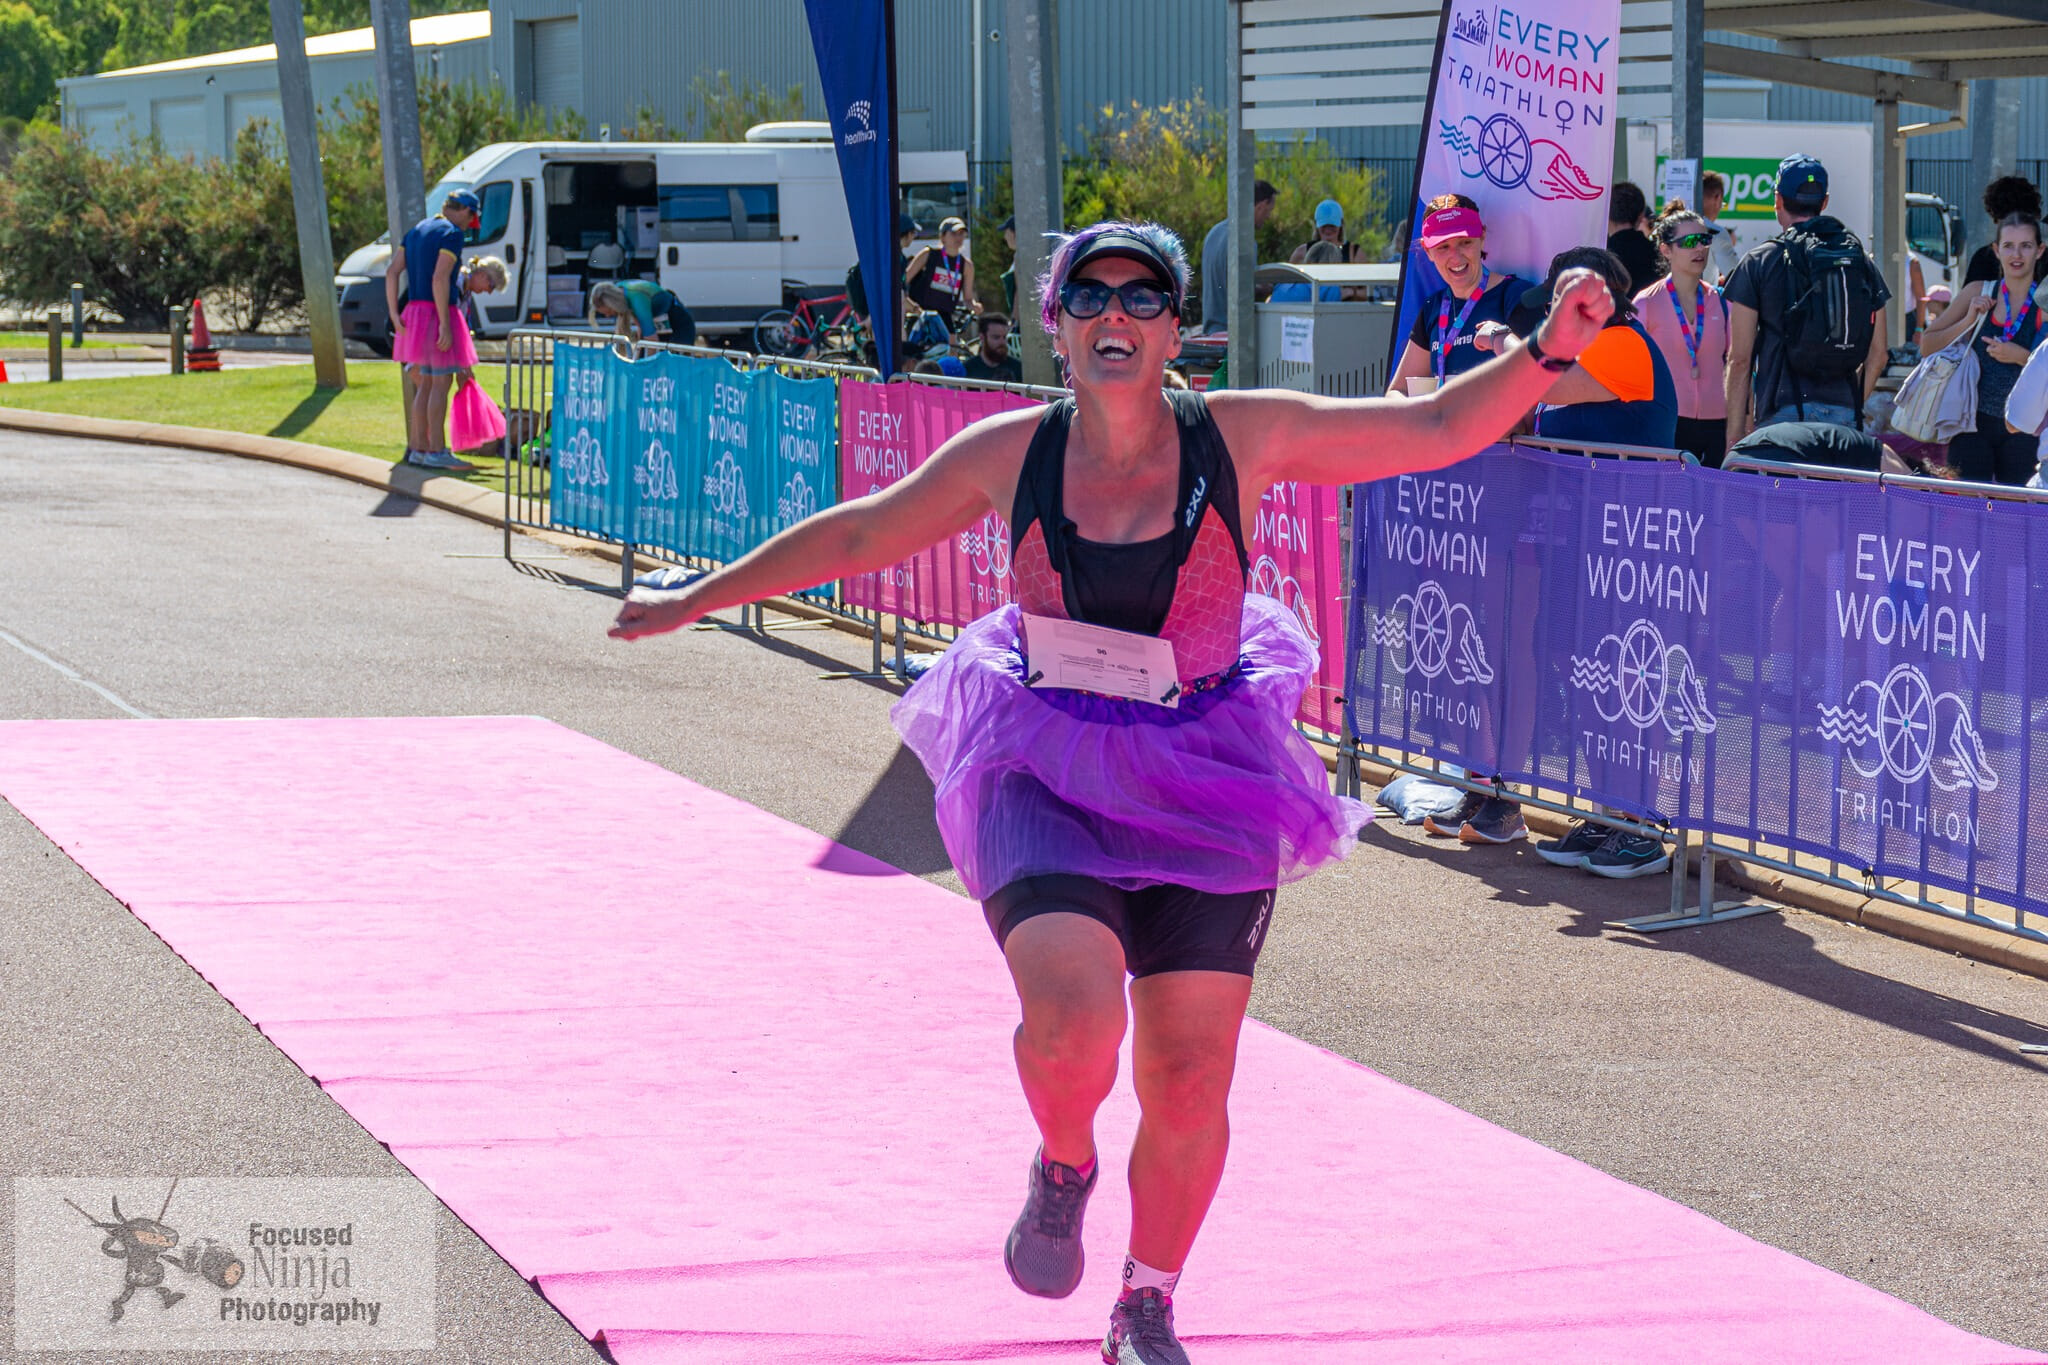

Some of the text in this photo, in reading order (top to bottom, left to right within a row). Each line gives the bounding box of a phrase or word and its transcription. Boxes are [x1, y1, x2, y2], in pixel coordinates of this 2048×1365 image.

[1498, 9, 1609, 63] EVERY
[1495, 45, 1604, 95] WOMAN
[1449, 56, 1604, 135] TRIATHLON
[568, 367, 605, 394] EVERY
[642, 376, 676, 402] EVERY
[714, 383, 748, 415] EVERY
[564, 395, 607, 424] WOMAN
[638, 407, 677, 435] WOMAN
[709, 414, 748, 449] WOMAN
[782, 398, 817, 432] EVERY
[858, 409, 903, 442] EVERY
[779, 432, 819, 468] WOMAN
[853, 444, 908, 479] WOMAN
[1398, 474, 1484, 524] EVERY
[1385, 520, 1487, 577] WOMAN
[1602, 502, 1705, 556] EVERY
[1586, 552, 1708, 616] WOMAN
[1855, 533, 1981, 597] EVERY
[1835, 589, 1986, 662] WOMAN
[1381, 683, 1481, 731] TRIATHLON
[1582, 730, 1701, 785] TRIATHLON
[1834, 787, 1980, 847] TRIATHLON
